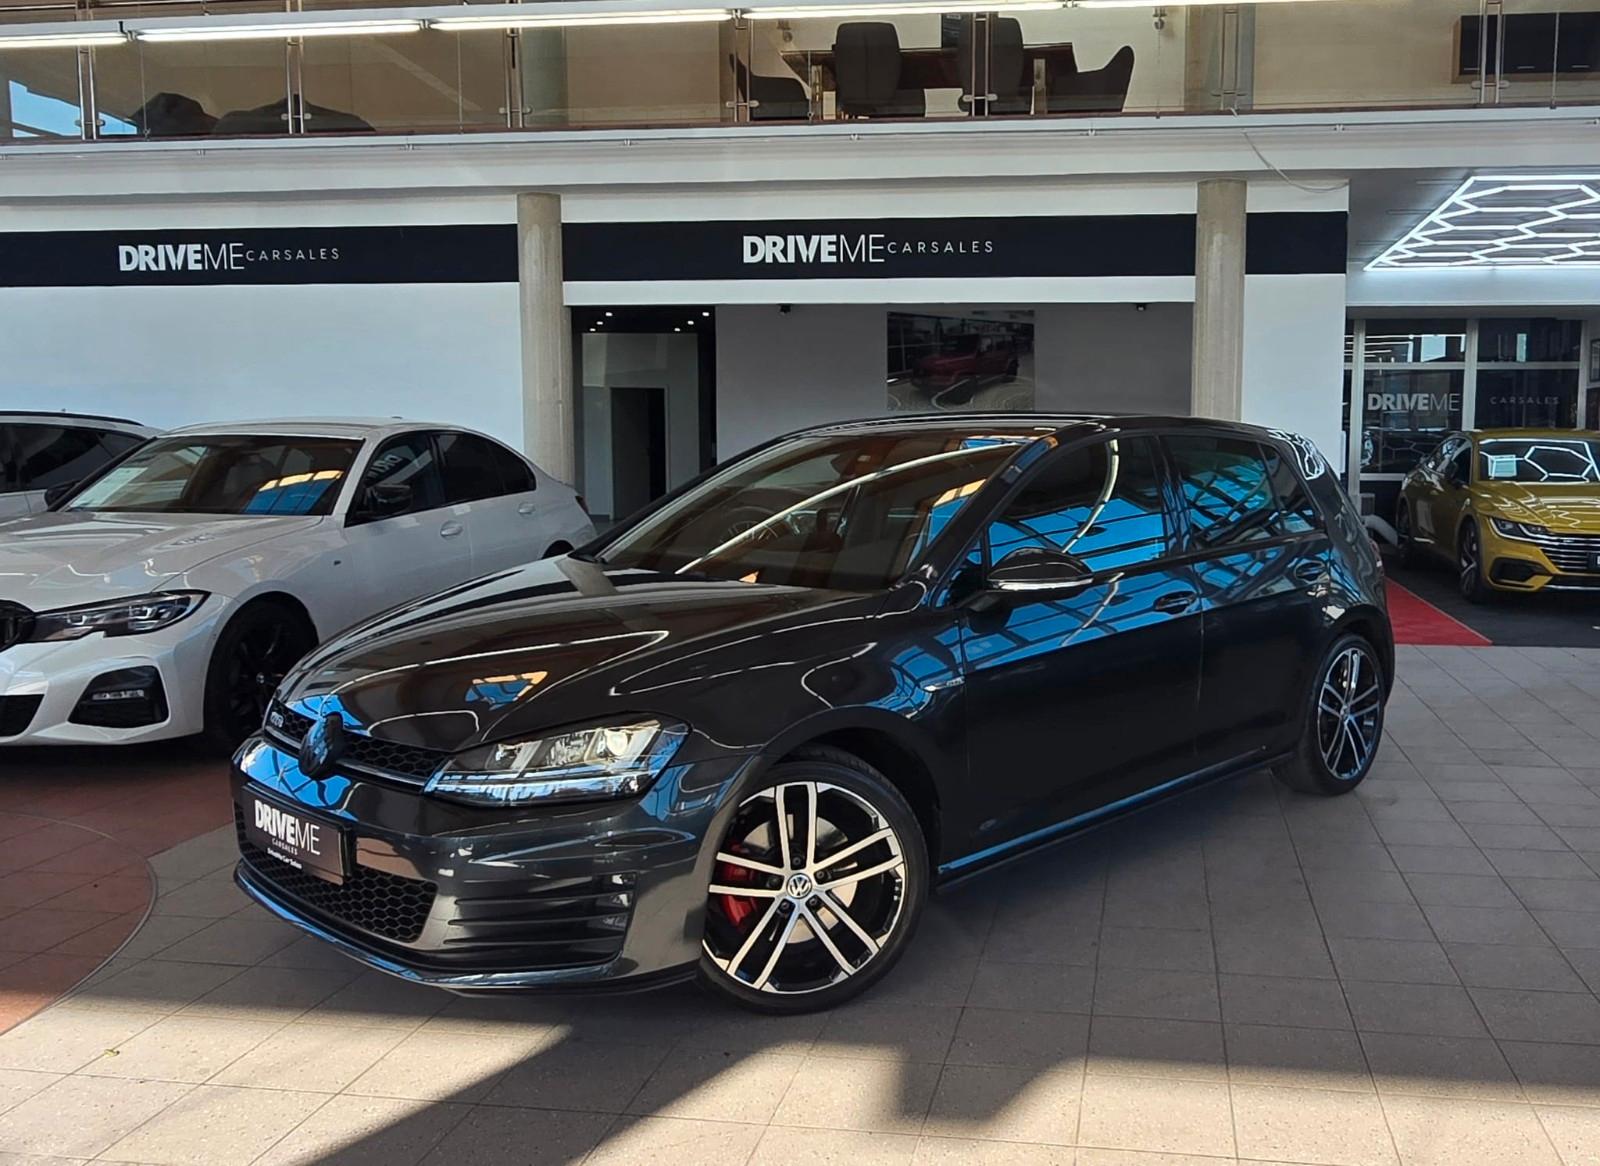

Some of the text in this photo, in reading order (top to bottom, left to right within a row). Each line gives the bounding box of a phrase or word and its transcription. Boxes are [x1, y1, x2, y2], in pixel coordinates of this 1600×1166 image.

[118, 243, 340, 272] DRIVEME CARSALES
[742, 233, 993, 264] DRIVEME CARSALES
[1367, 393, 1560, 412] DRIVEME CARSALES
[255, 799, 321, 856] DRIVEME
